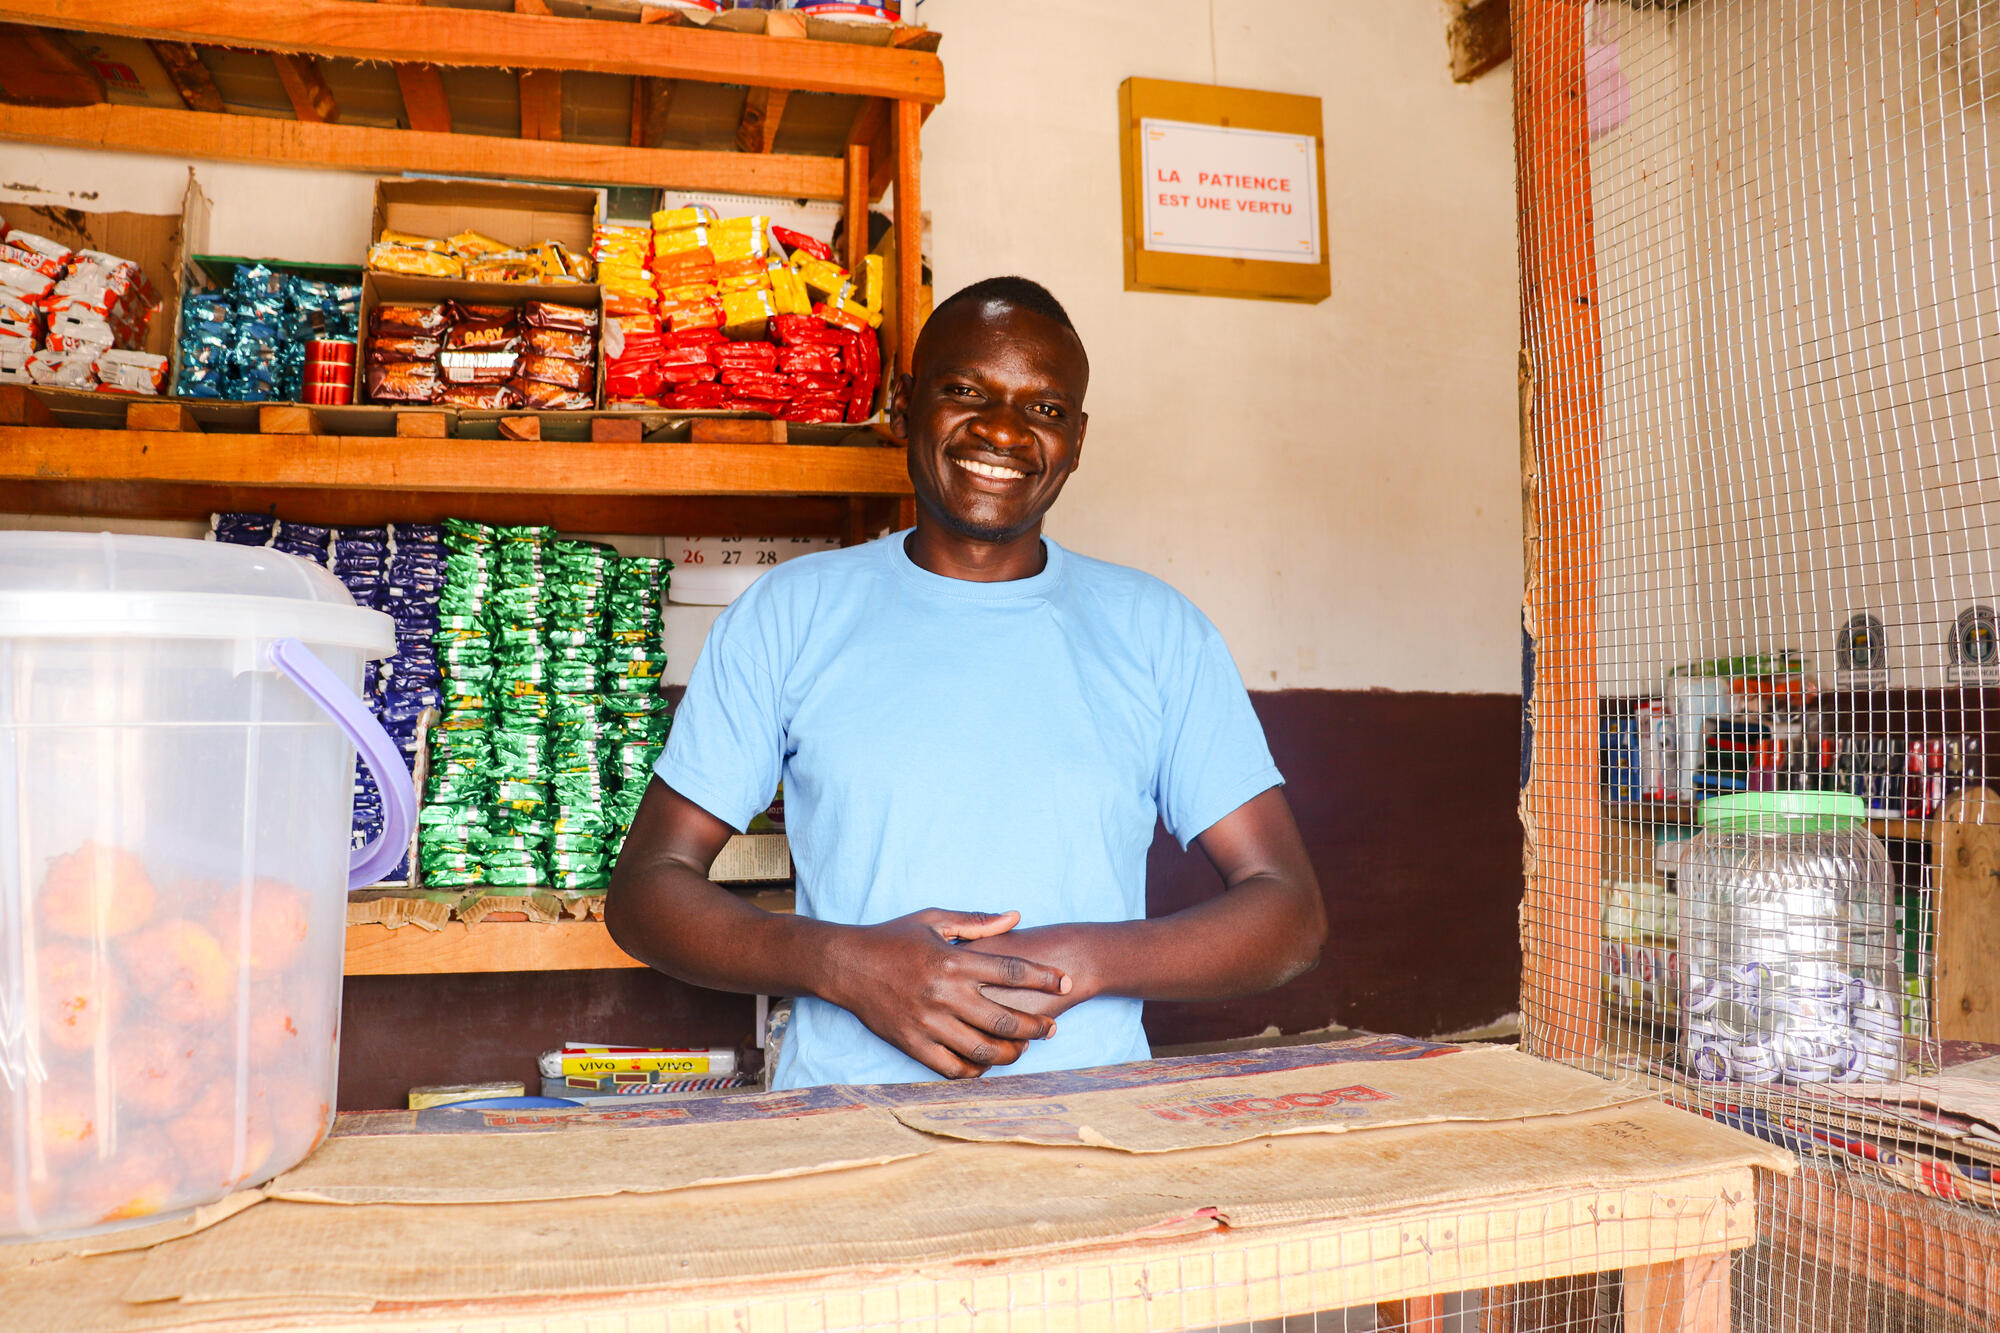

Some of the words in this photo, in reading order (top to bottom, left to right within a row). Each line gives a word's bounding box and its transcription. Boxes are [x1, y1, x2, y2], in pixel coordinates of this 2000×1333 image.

[1158, 168, 1181, 184] LA
[1198, 172, 1291, 192] PATIENCE
[1158, 193, 1190, 208] EST
[1196, 196, 1232, 211] UNE
[1236, 199, 1293, 215] VERTU
[465, 327, 504, 345] BABY
[682, 549, 705, 564] 26
[721, 550, 742, 564] 27
[755, 550, 777, 564] 28
[579, 1062, 616, 1072] VIVO
[657, 1061, 694, 1071] VIVO
